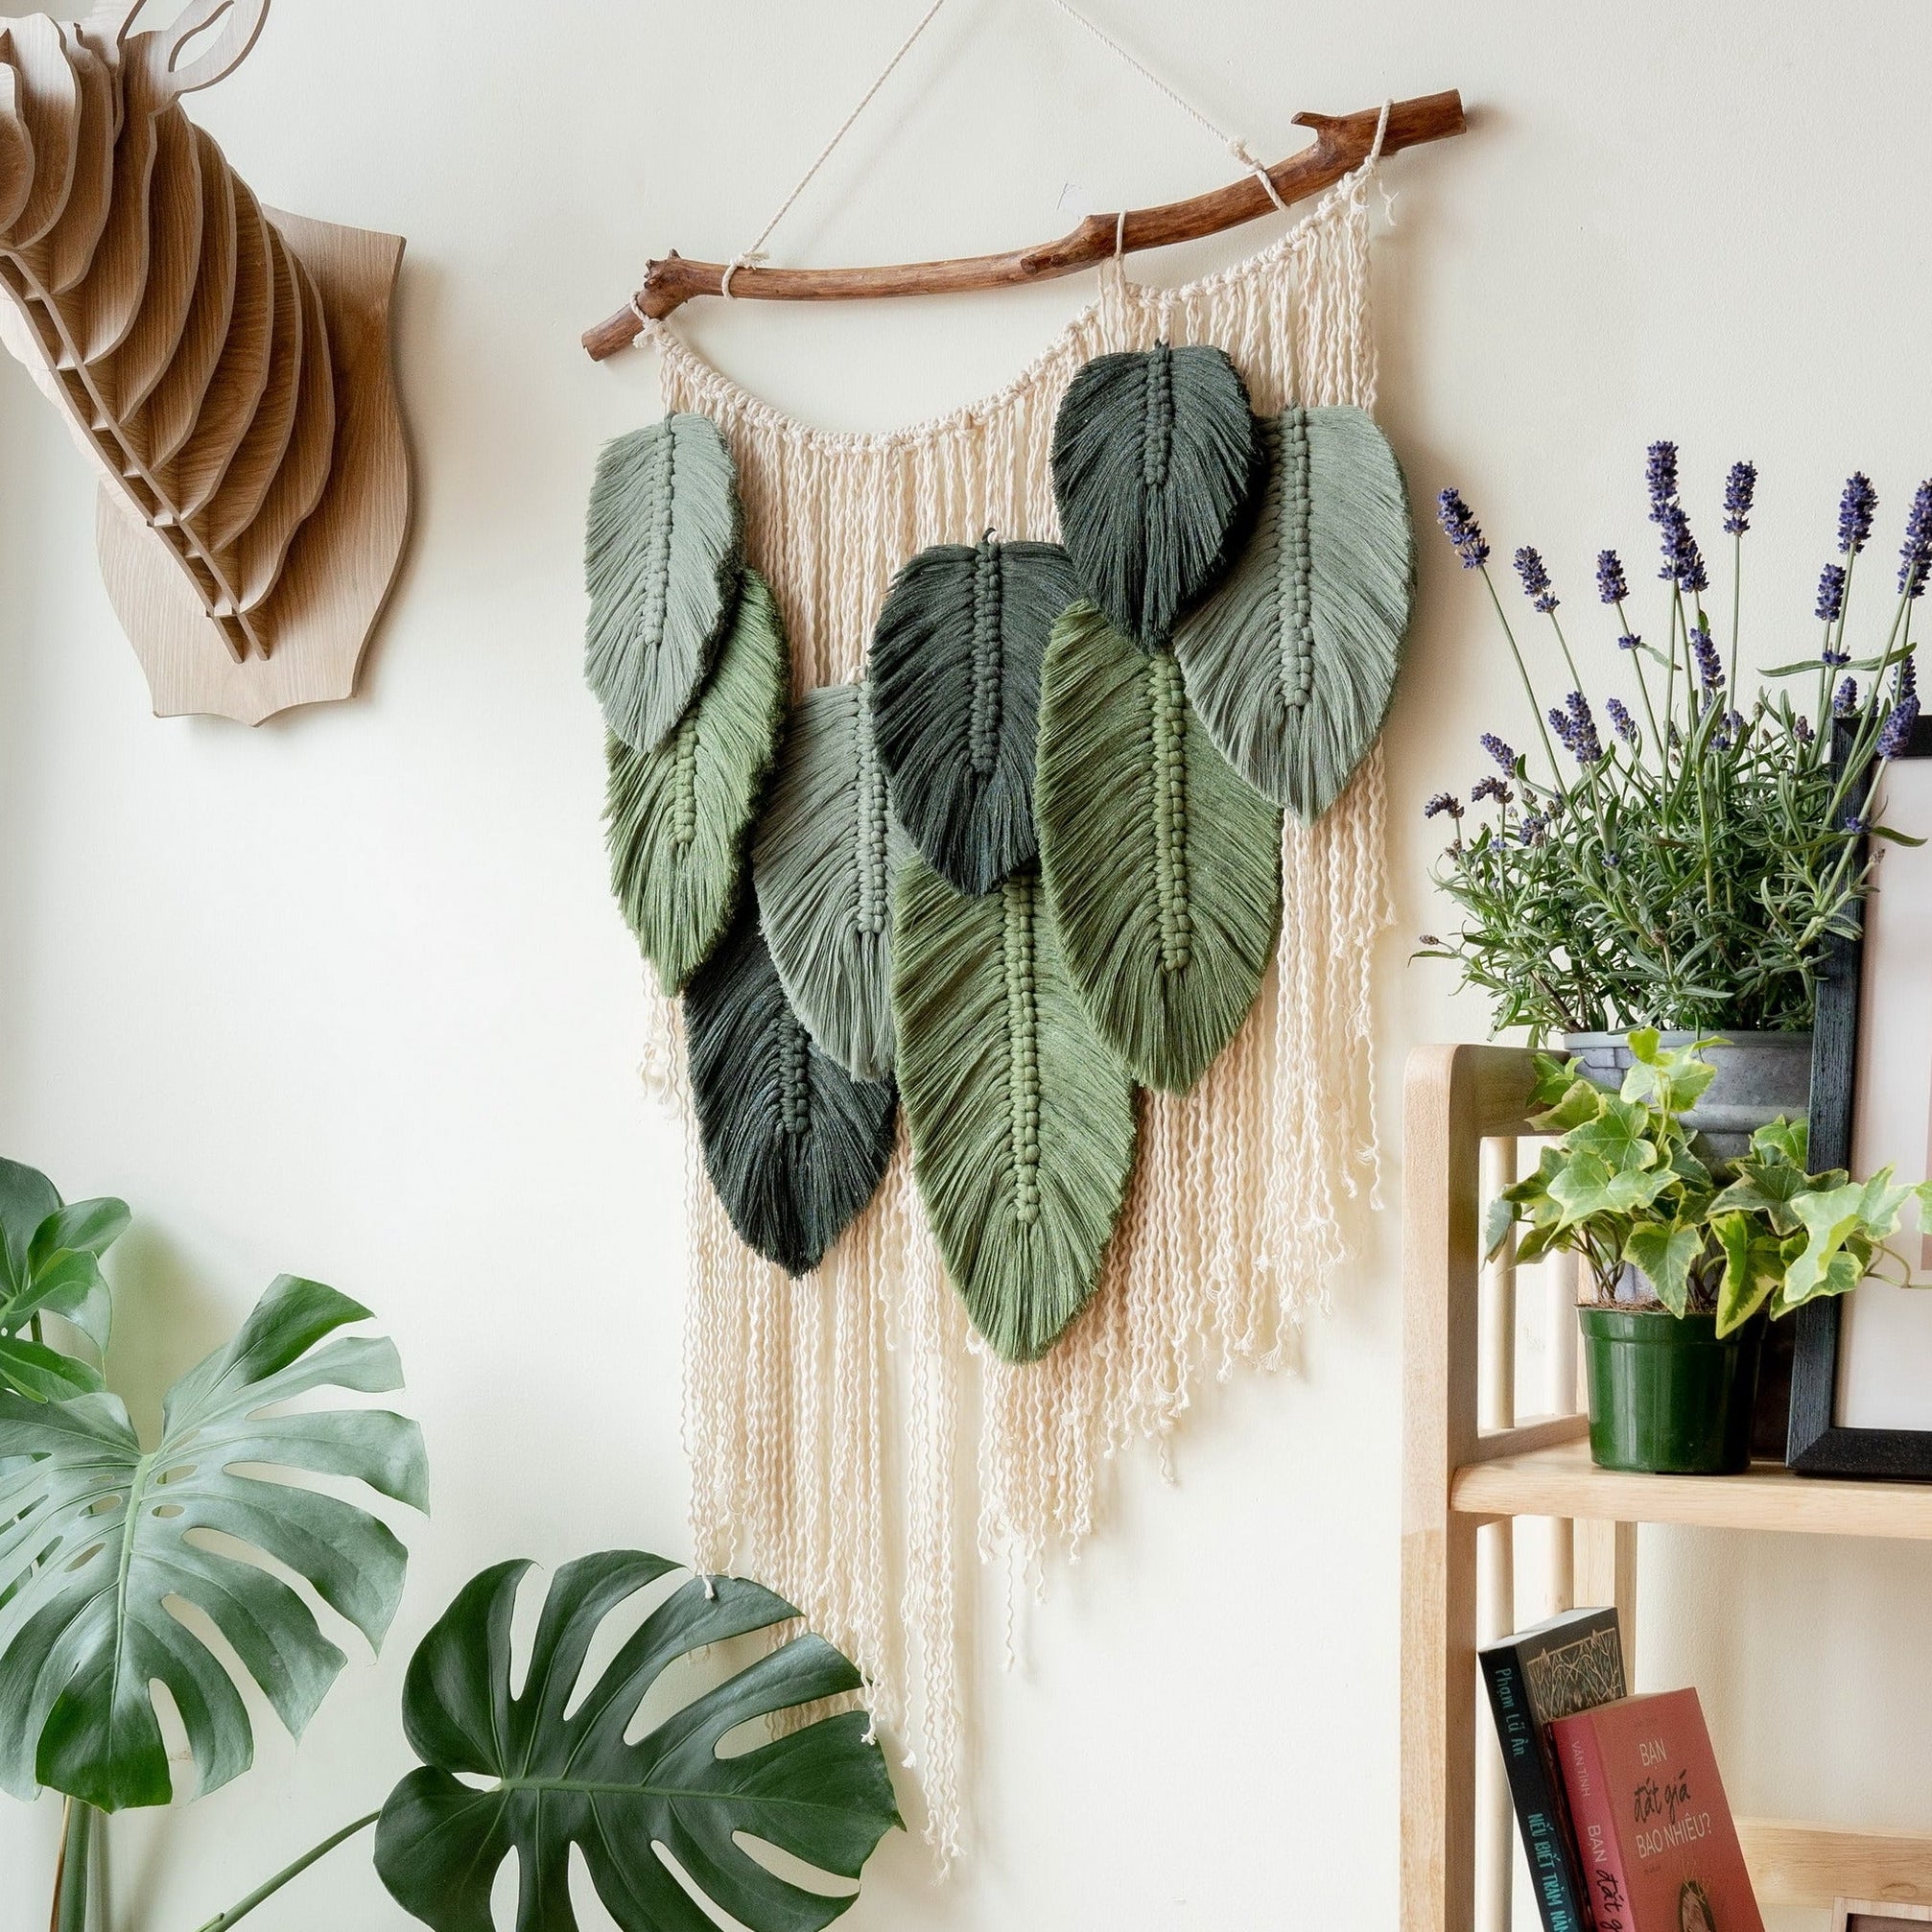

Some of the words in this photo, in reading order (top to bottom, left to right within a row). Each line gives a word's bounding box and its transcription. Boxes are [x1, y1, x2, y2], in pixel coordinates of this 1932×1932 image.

[1495, 1667, 1515, 1709] Phạm
[1638, 1737, 1667, 1770] BẠN
[1664, 1769, 1690, 1825] giá
[1527, 1813, 1554, 1837] NẾU
[1588, 1825, 1608, 1863] BẠN
[1636, 1828, 1663, 1858] BAO
[1663, 1812, 1711, 1848] NHIÊU?
[1535, 1841, 1561, 1868] BIẾT
